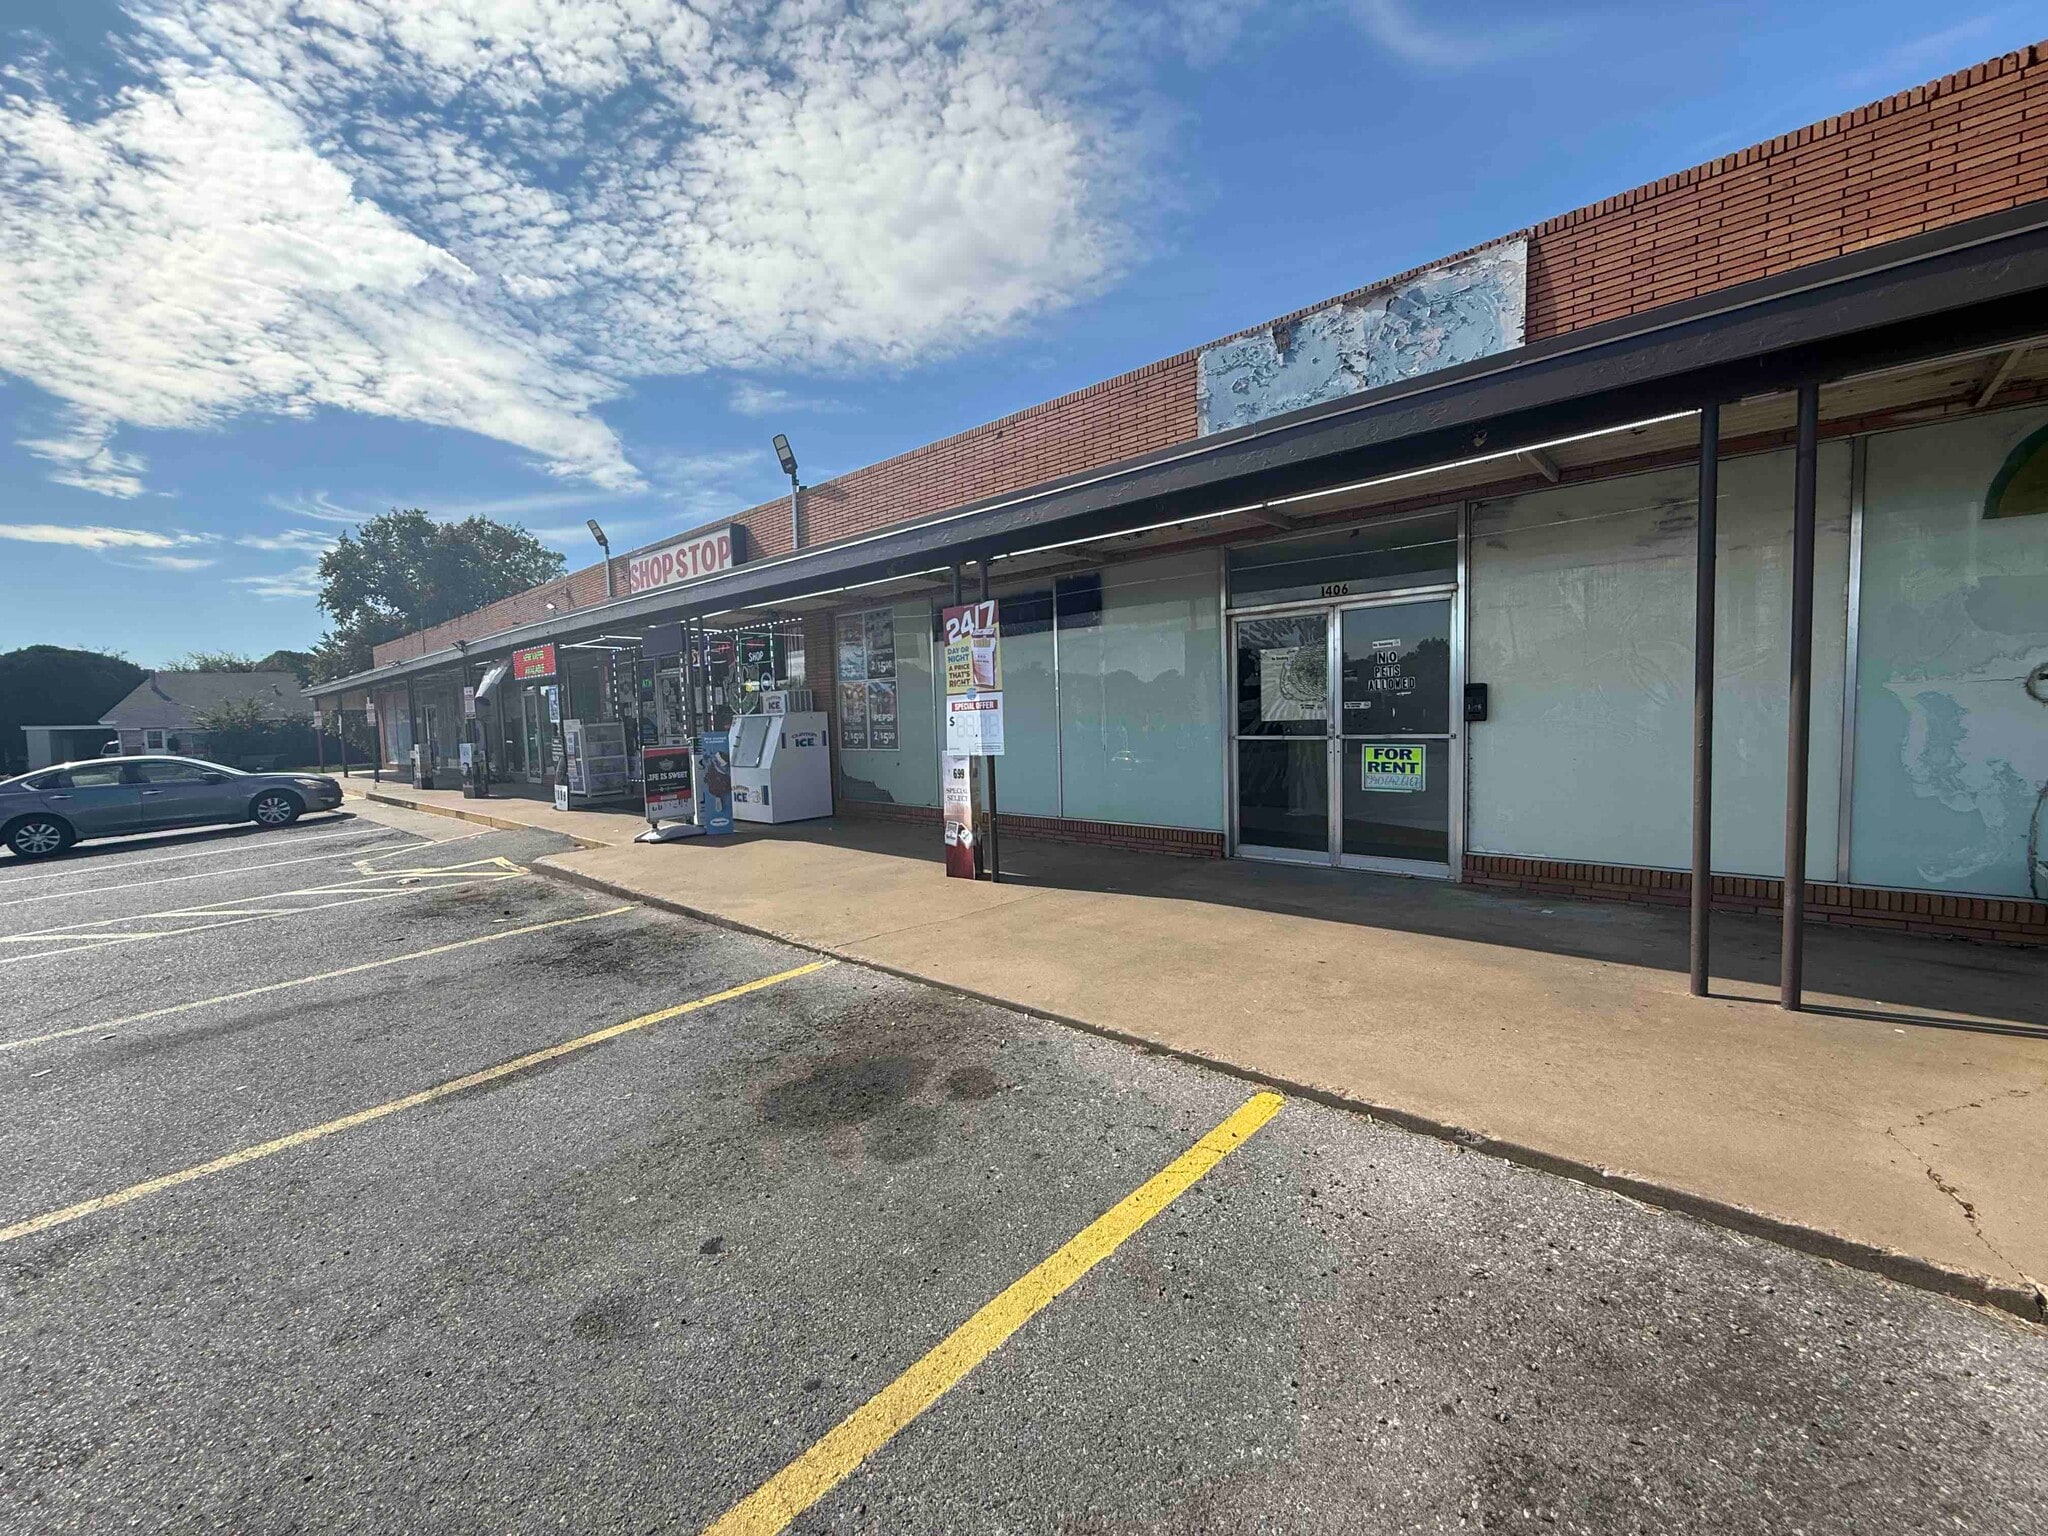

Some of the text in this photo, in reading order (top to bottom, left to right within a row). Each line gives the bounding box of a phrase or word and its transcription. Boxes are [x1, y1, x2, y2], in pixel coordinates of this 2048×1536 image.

[631, 535, 732, 592] SHOP STOP
[1321, 583, 1349, 597] 1406
[748, 650, 764, 662] SHOP
[947, 647, 959, 655] DAY
[947, 654, 970, 663] NIGHT
[1378, 651, 1397, 664] NO
[954, 663, 970, 671] PRICE
[1374, 664, 1400, 677] PETS
[948, 671, 970, 680] THAT'S
[948, 678, 970, 688] RIGHT
[1367, 677, 1415, 691] ALLOWED
[768, 700, 780, 710] ICE
[954, 701, 994, 711] SPECIAL OFFER
[873, 713, 894, 722] PEPSI
[795, 738, 815, 748] ICE
[1373, 748, 1413, 761] FOR
[1367, 761, 1420, 774] RENT
[660, 772, 668, 780] IS
[668, 771, 688, 779] SWEET
[953, 768, 965, 779] 699
[733, 792, 748, 803] ICE
[946, 794, 968, 802] SELECT
